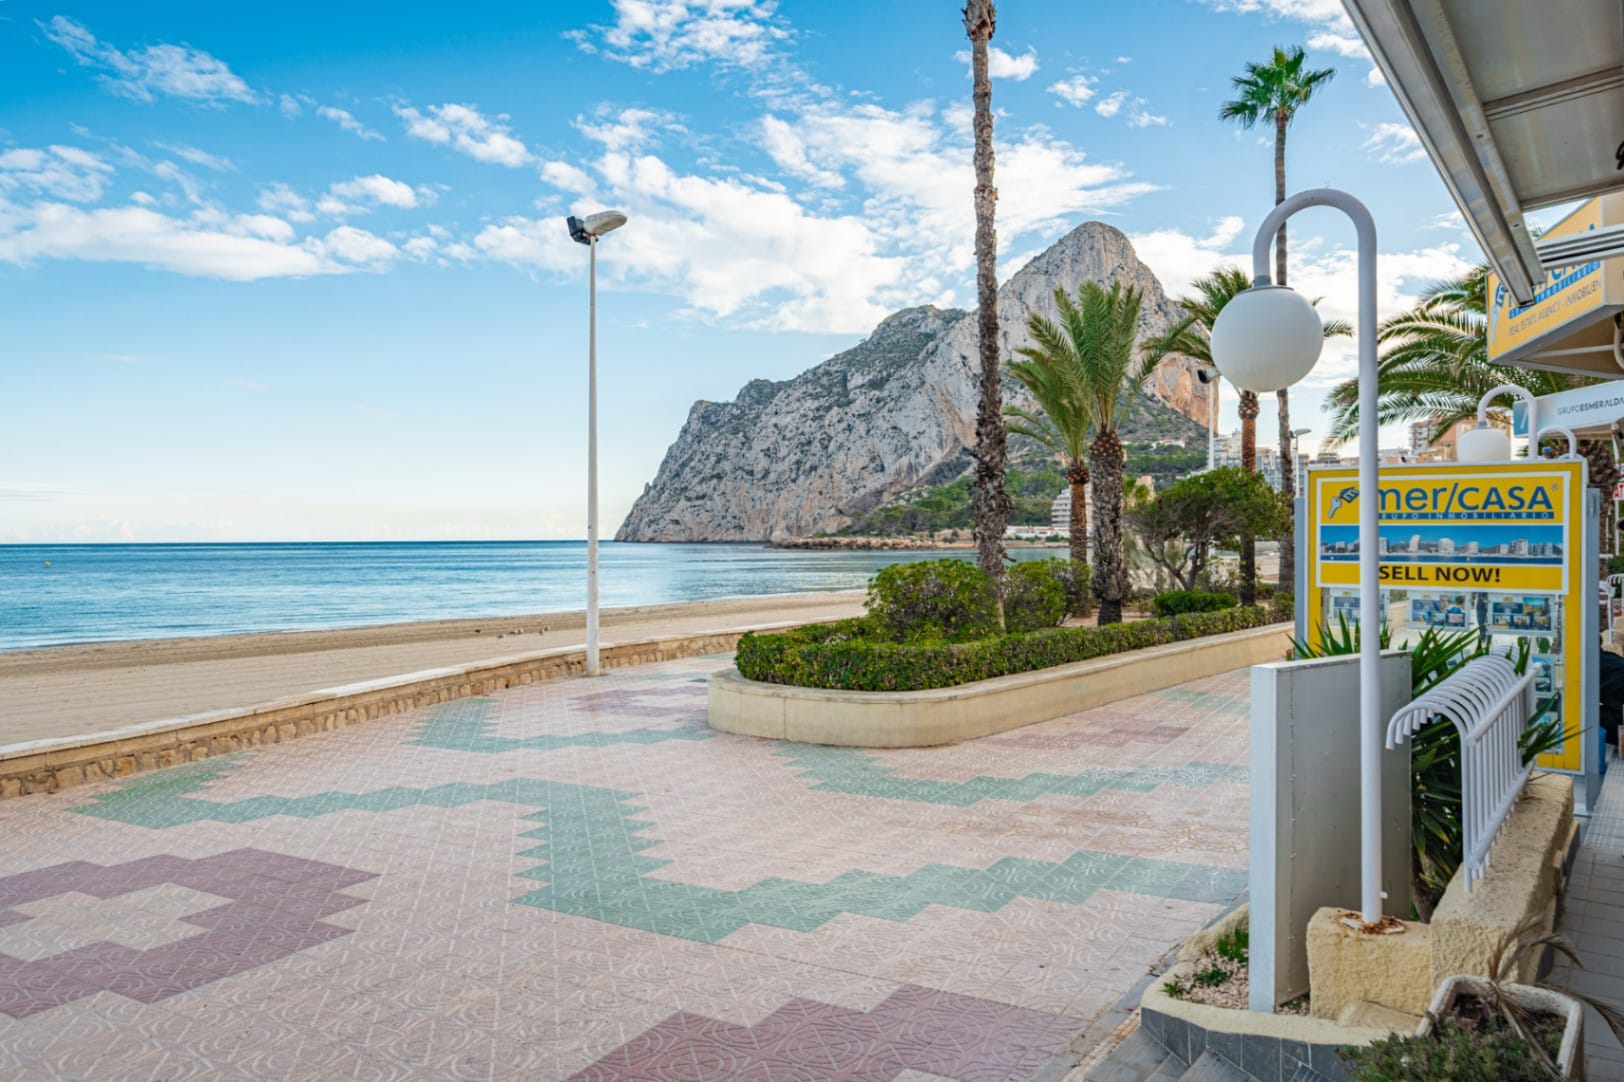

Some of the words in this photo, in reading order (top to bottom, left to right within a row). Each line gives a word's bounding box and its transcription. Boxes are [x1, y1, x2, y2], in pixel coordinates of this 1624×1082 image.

[1380, 512, 1420, 520] RUPO
[1378, 565, 1429, 582] SELL
[1435, 566, 1502, 583] NOW!
